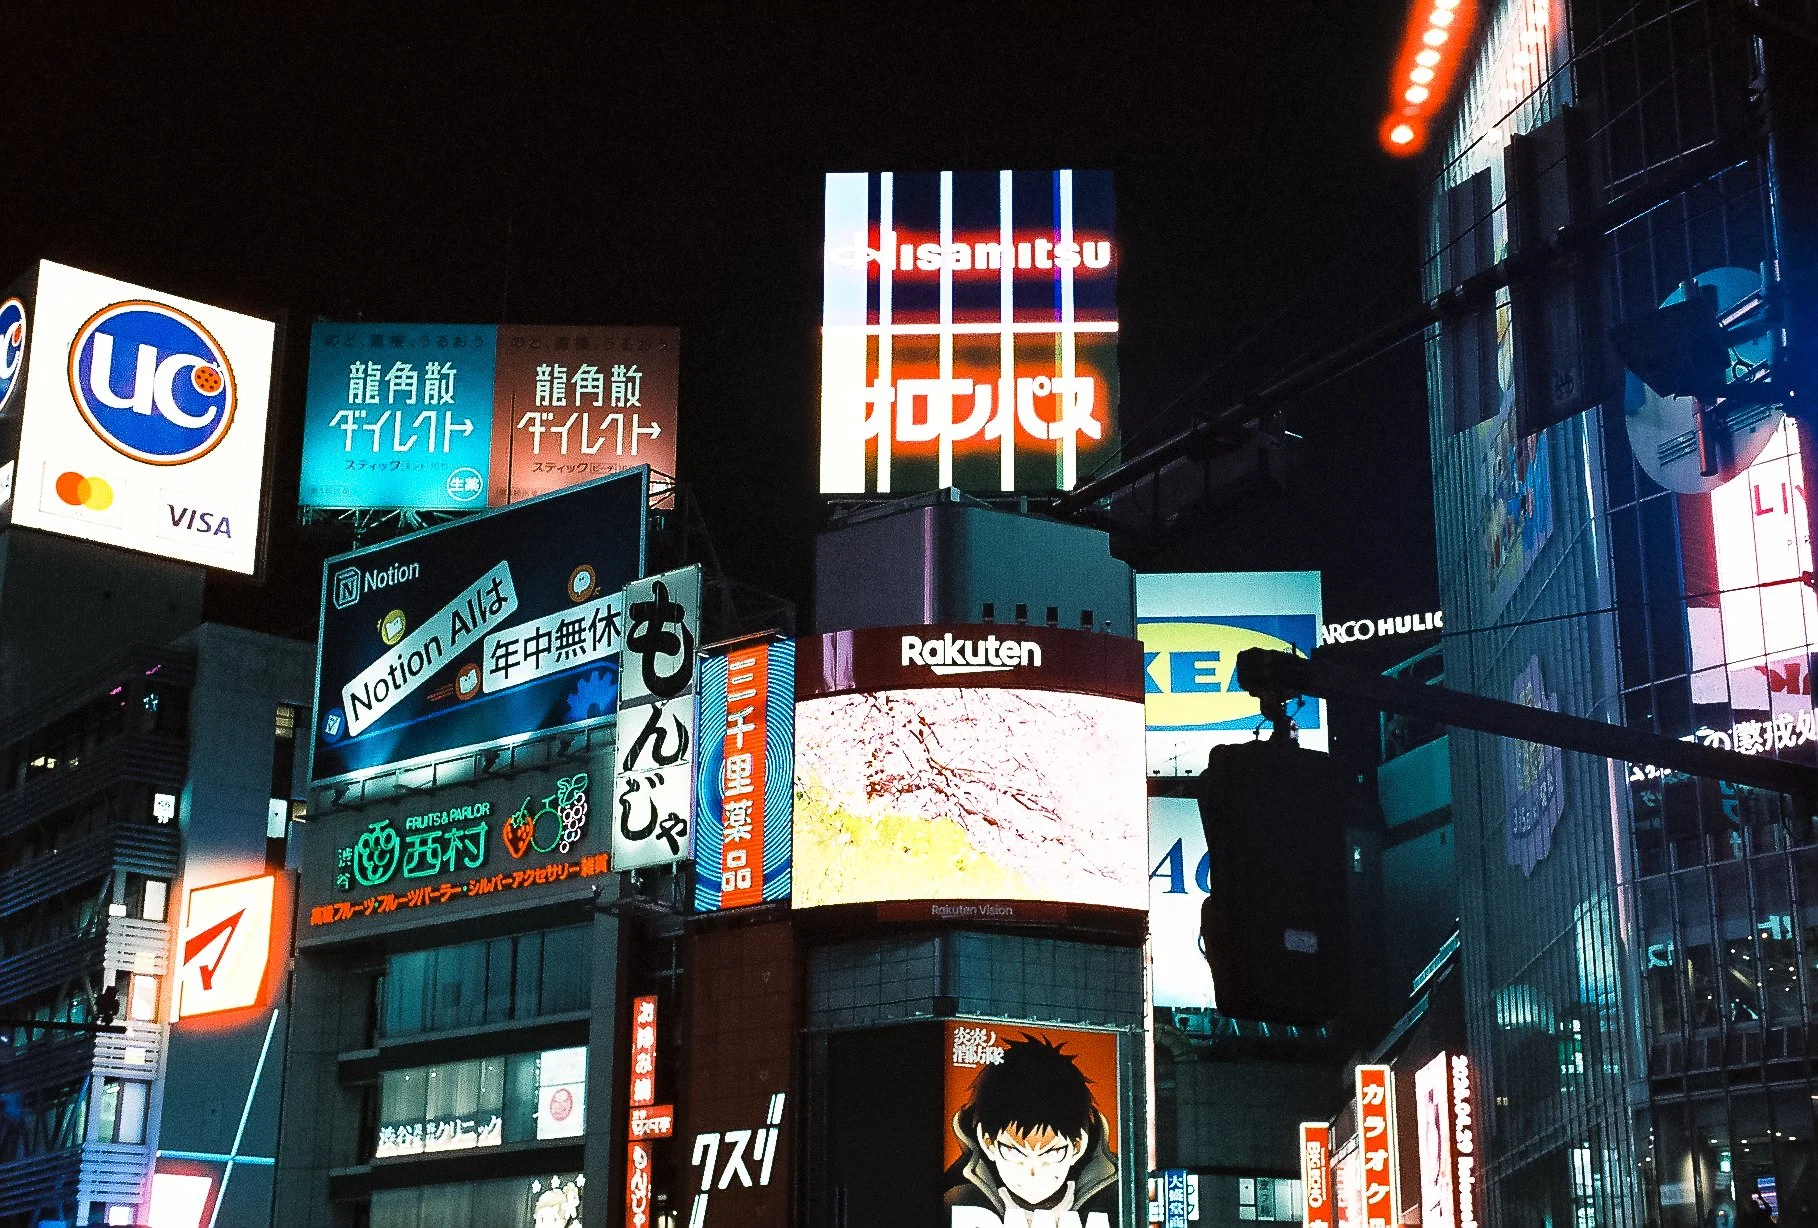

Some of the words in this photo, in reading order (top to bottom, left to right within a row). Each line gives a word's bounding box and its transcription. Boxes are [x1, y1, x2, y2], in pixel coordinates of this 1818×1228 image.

[855, 231, 1111, 270] Hisamitsu
[90, 331, 219, 429] UC
[348, 360, 457, 405] 龍角散
[535, 363, 643, 408] 龍角散
[329, 410, 474, 454] ダイレクト
[516, 412, 662, 456] ダイレクト
[450, 476, 480, 492] 生薬
[532, 462, 588, 473] スティック
[167, 504, 232, 538] VISA
[364, 563, 419, 593] Notion
[490, 604, 621, 680] 年中無休
[1378, 610, 1444, 636] HULIC
[901, 633, 1041, 668] Rakuten
[349, 641, 442, 722] Notion
[619, 580, 695, 856] もんじゃ
[721, 658, 757, 892] 三千里薬品
[403, 821, 489, 878] 西村
[692, 1128, 779, 1191] クスリ
[1362, 1084, 1390, 1205] カラオケ
